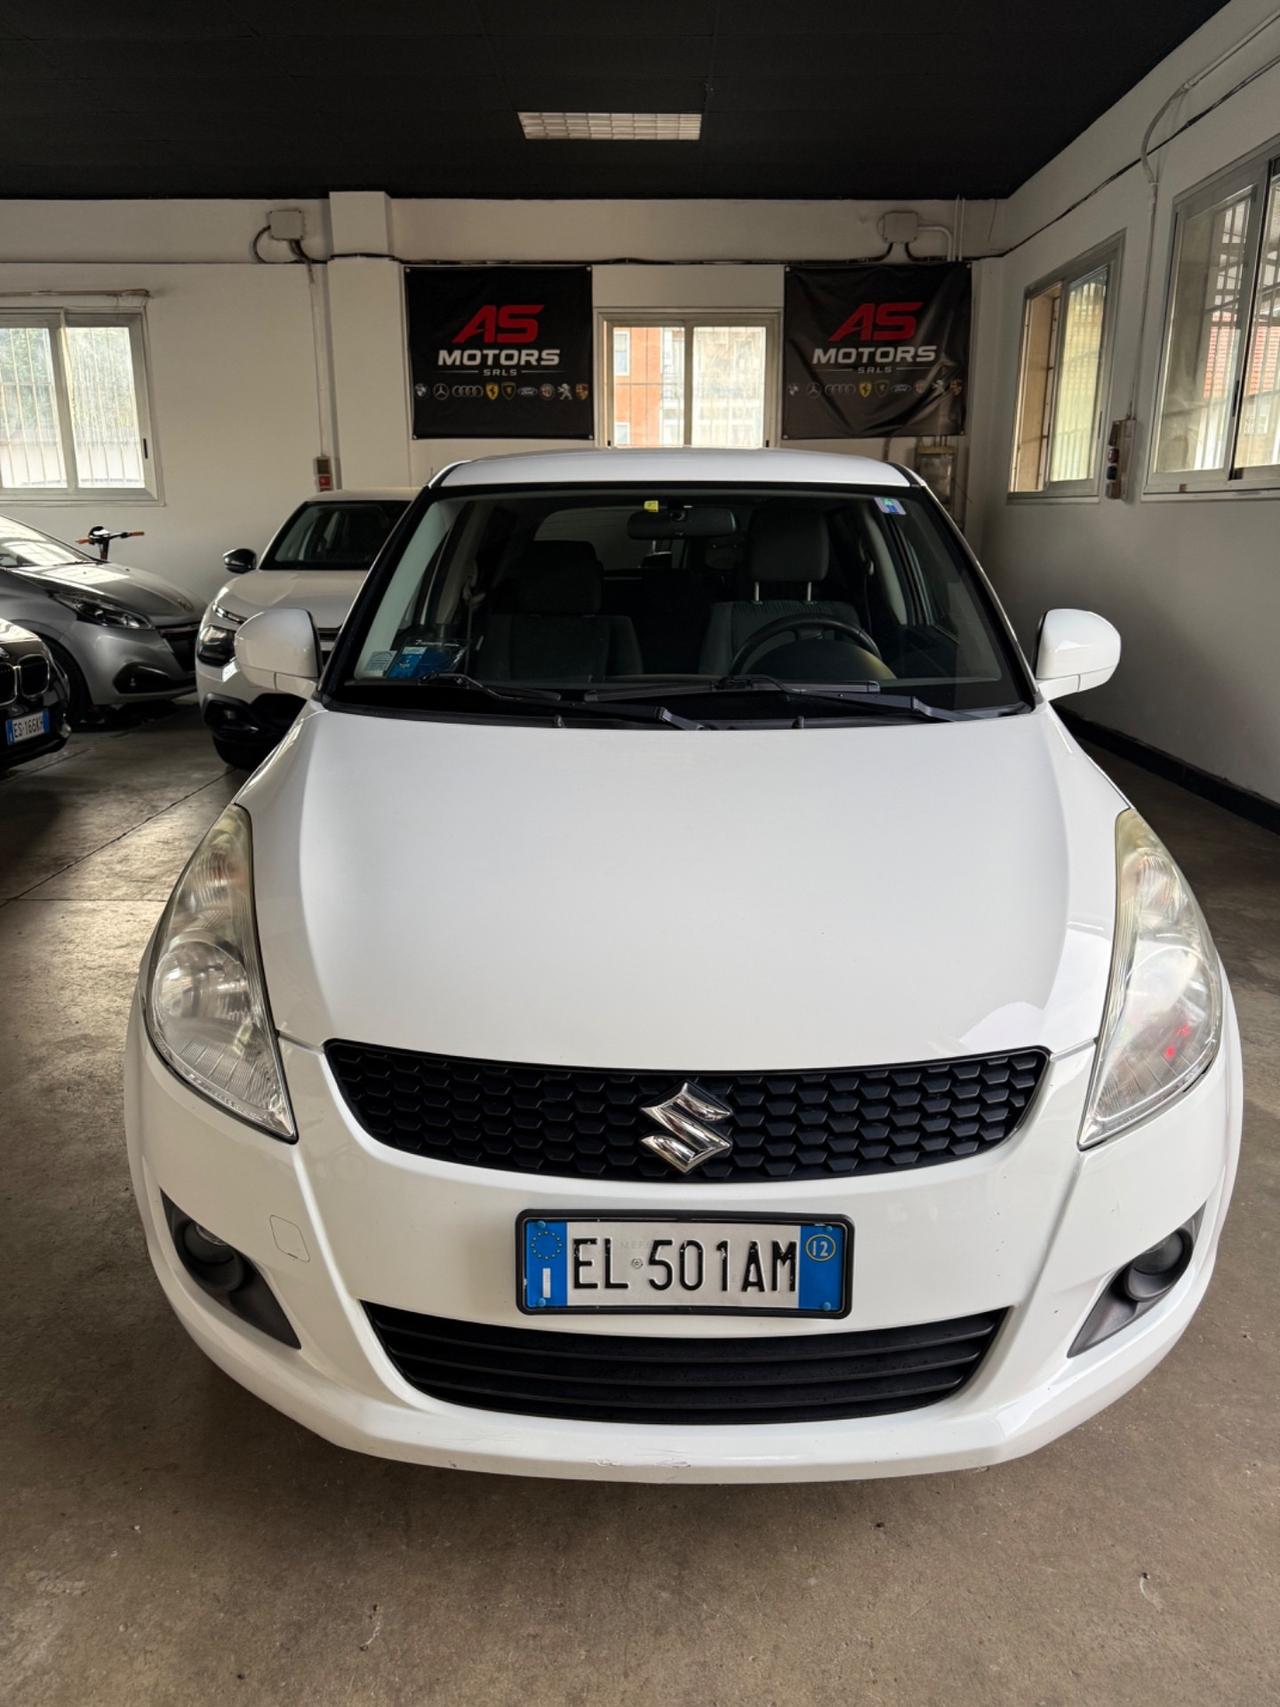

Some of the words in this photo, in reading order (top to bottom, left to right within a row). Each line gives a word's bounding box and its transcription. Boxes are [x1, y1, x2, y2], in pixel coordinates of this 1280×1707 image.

[452, 304, 544, 344] AS
[828, 302, 924, 342] AS
[438, 349, 560, 366] MOTORS
[812, 345, 937, 364] MOTORS
[857, 366, 893, 374] SRLS
[812, 1240, 829, 1257] 12
[573, 1238, 629, 1289] EL
[648, 1240, 797, 1292] 501AM
